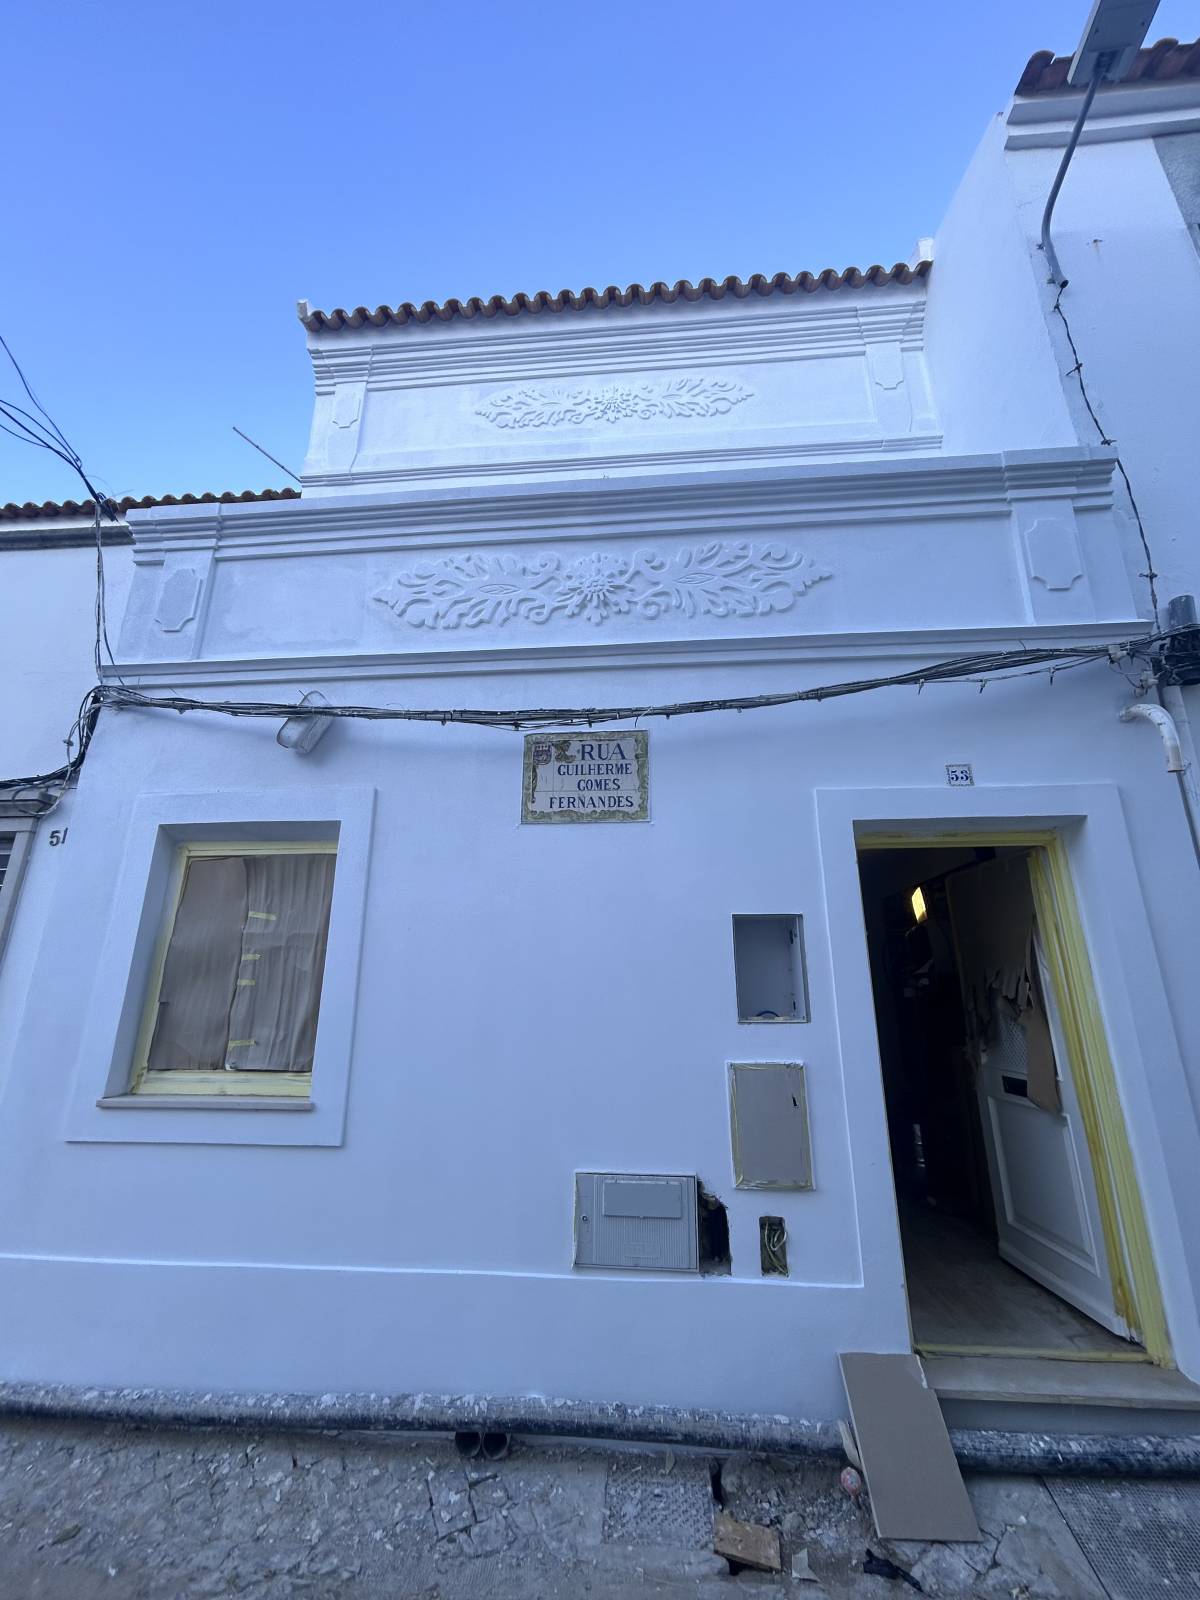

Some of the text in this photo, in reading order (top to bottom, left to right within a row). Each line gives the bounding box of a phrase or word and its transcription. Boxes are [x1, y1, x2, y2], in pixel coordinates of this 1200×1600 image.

[580, 743, 626, 761] RUA
[557, 763, 633, 776] GUILHERME
[950, 769, 969, 781] 53
[577, 779, 621, 792] GOMES
[549, 795, 634, 809] FERNANDES
[49, 827, 69, 847] 51
